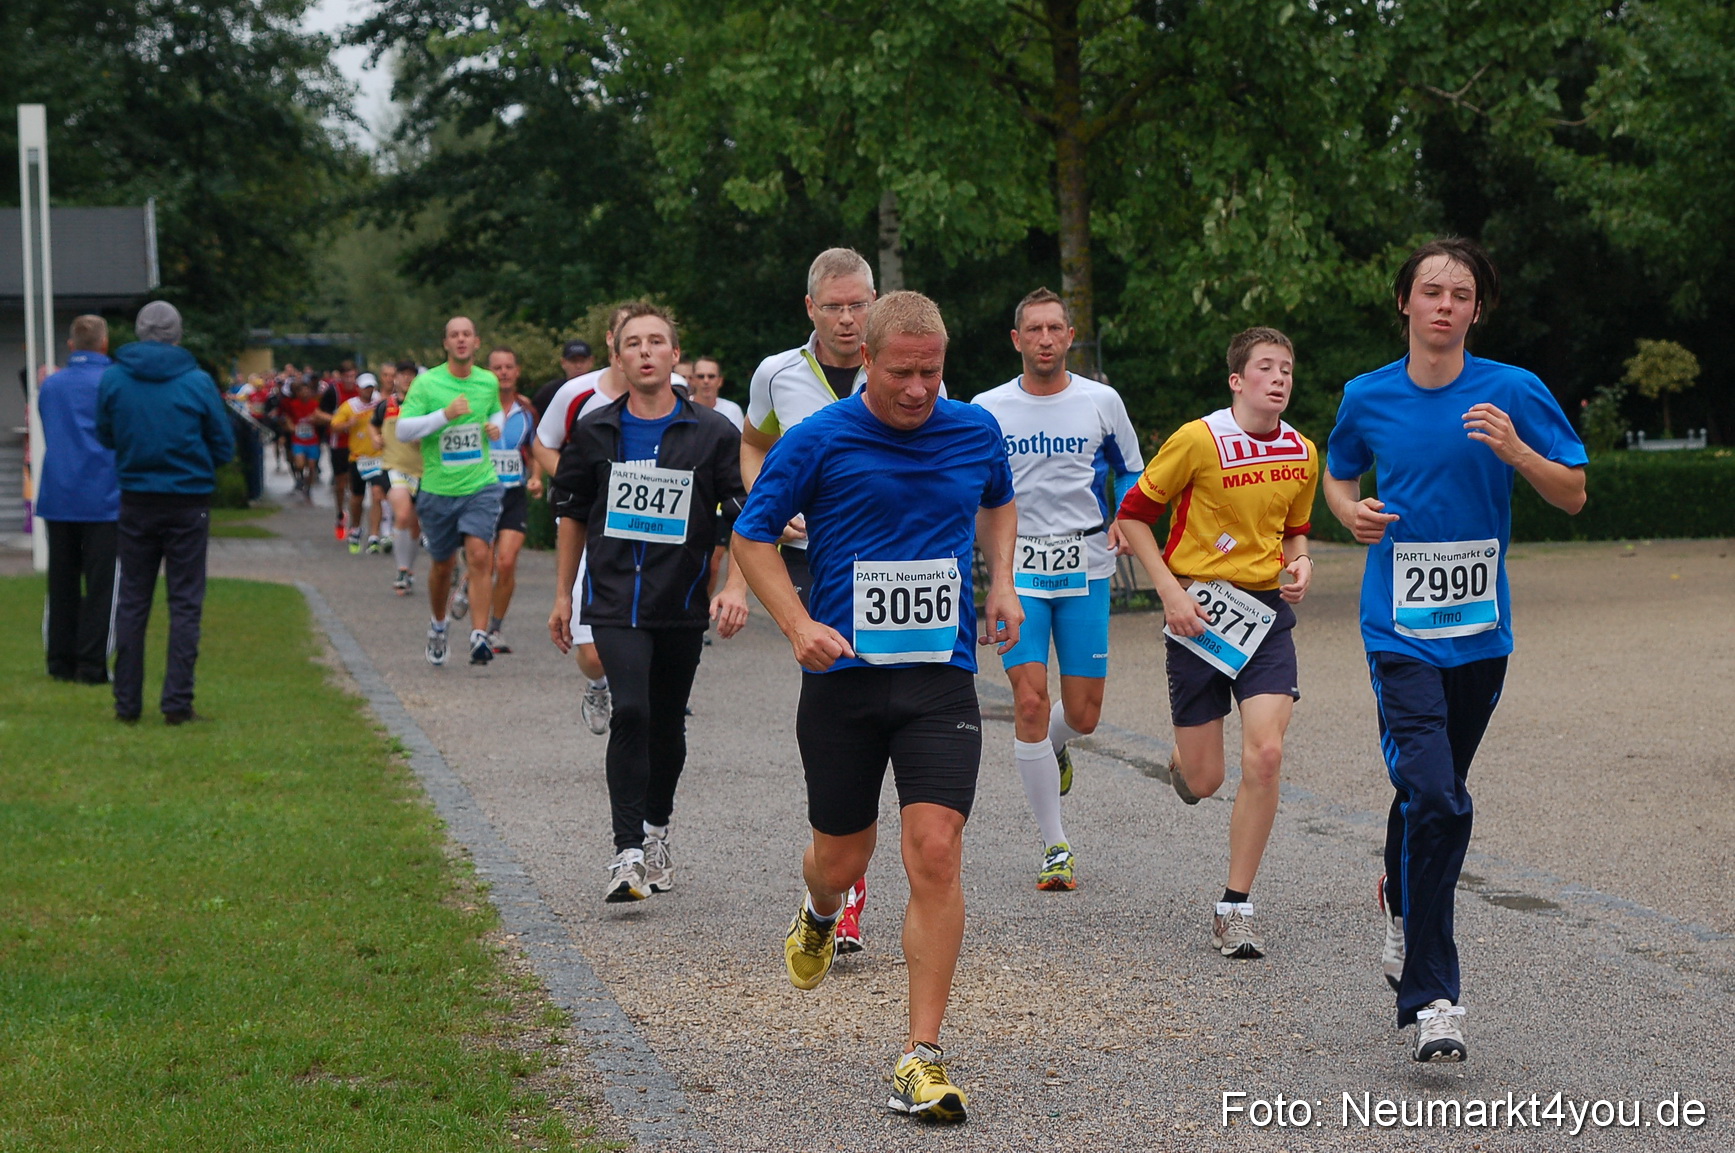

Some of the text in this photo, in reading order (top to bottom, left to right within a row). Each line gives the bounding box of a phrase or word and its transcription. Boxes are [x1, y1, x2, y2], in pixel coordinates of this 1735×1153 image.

[443, 433, 478, 450] 2942
[1003, 431, 1088, 458] Gothaer
[612, 470, 678, 485] PARTL Neumarkt
[1222, 464, 1308, 489] MAX BÖGL
[616, 482, 684, 514] 2847
[627, 518, 663, 533] Jürgen
[1022, 545, 1080, 571] 2123
[1396, 550, 1480, 561] PARTL Neumarkt
[856, 570, 945, 581] PARTL Neumarkt
[1032, 576, 1069, 589] Gerhard
[1405, 562, 1488, 602] 2990
[865, 584, 952, 625] 3056
[1223, 590, 1260, 618] Neumarkt
[1431, 611, 1462, 625] Timo
[1196, 633, 1222, 654] onas
